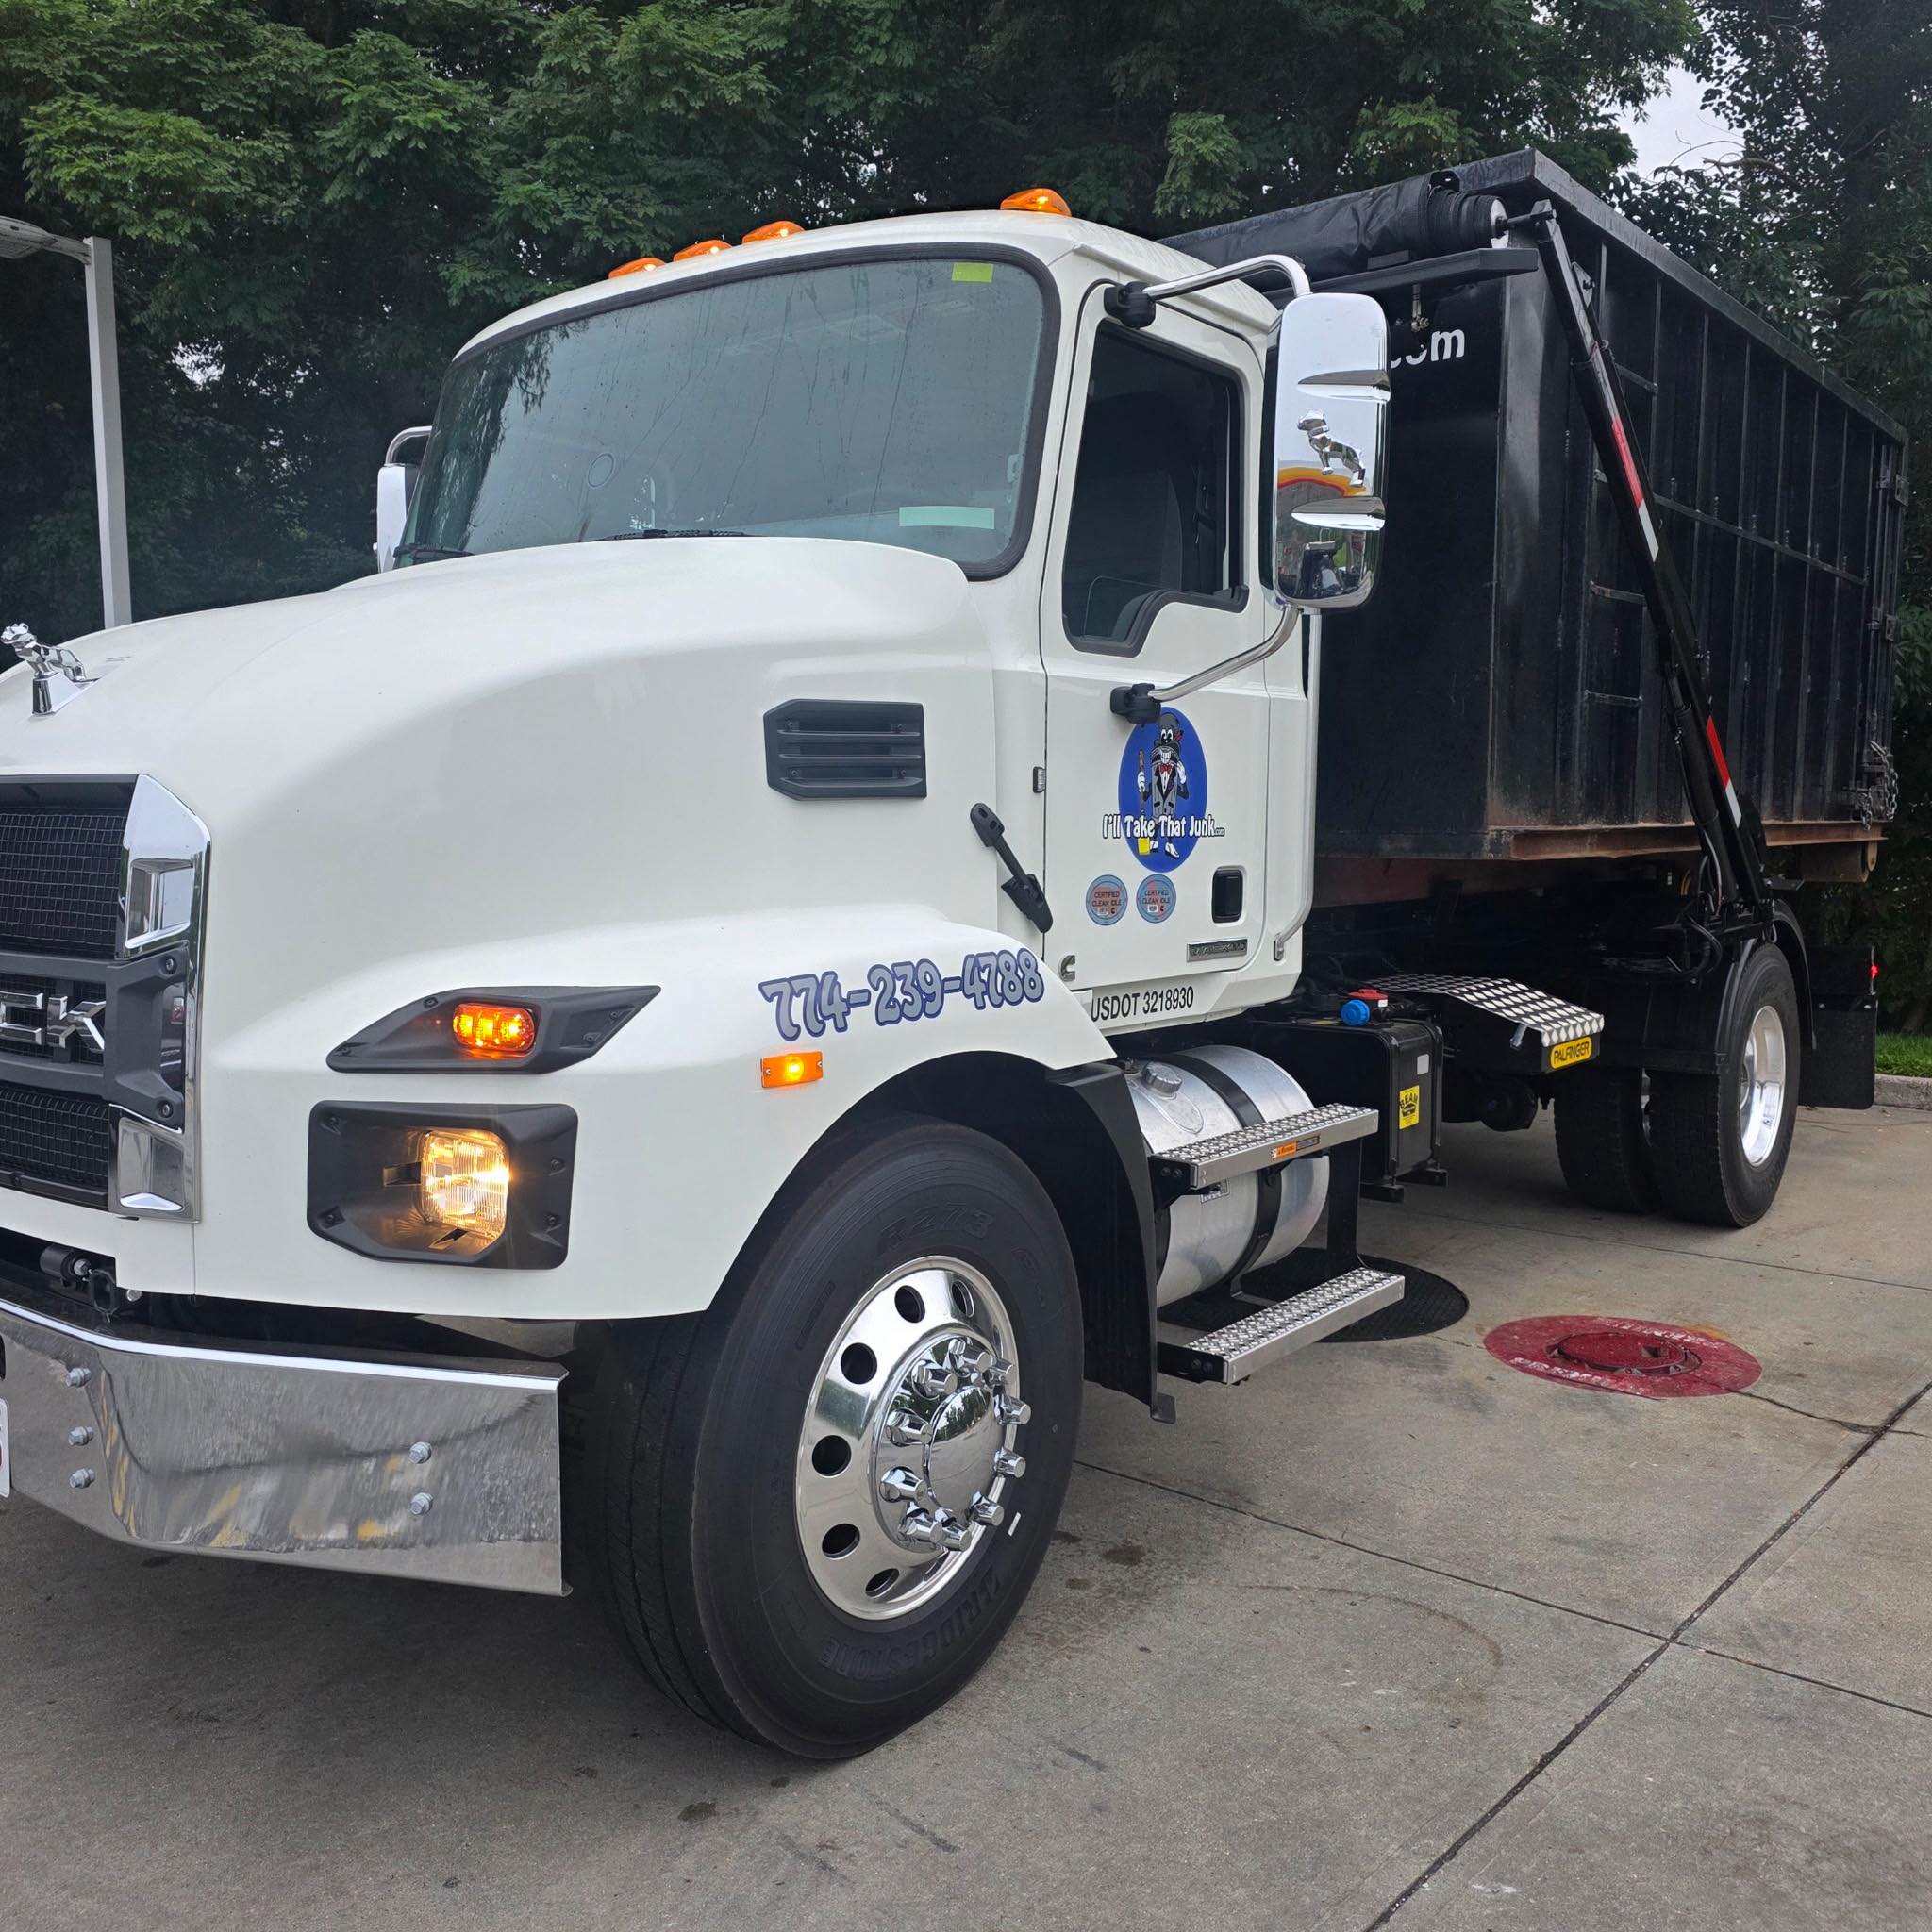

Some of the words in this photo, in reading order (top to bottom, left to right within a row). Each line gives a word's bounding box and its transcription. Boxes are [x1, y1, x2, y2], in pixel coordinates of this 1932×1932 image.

[1102, 813, 1122, 839] I'll
[1124, 813, 1156, 838] Take
[1158, 813, 1187, 838] That
[758, 947, 1044, 1041] 774-239-4788
[1091, 992, 1140, 1022] USDOT
[1142, 986, 1193, 1014] 3218930
[1554, 1041, 1590, 1065] PALFINGER
